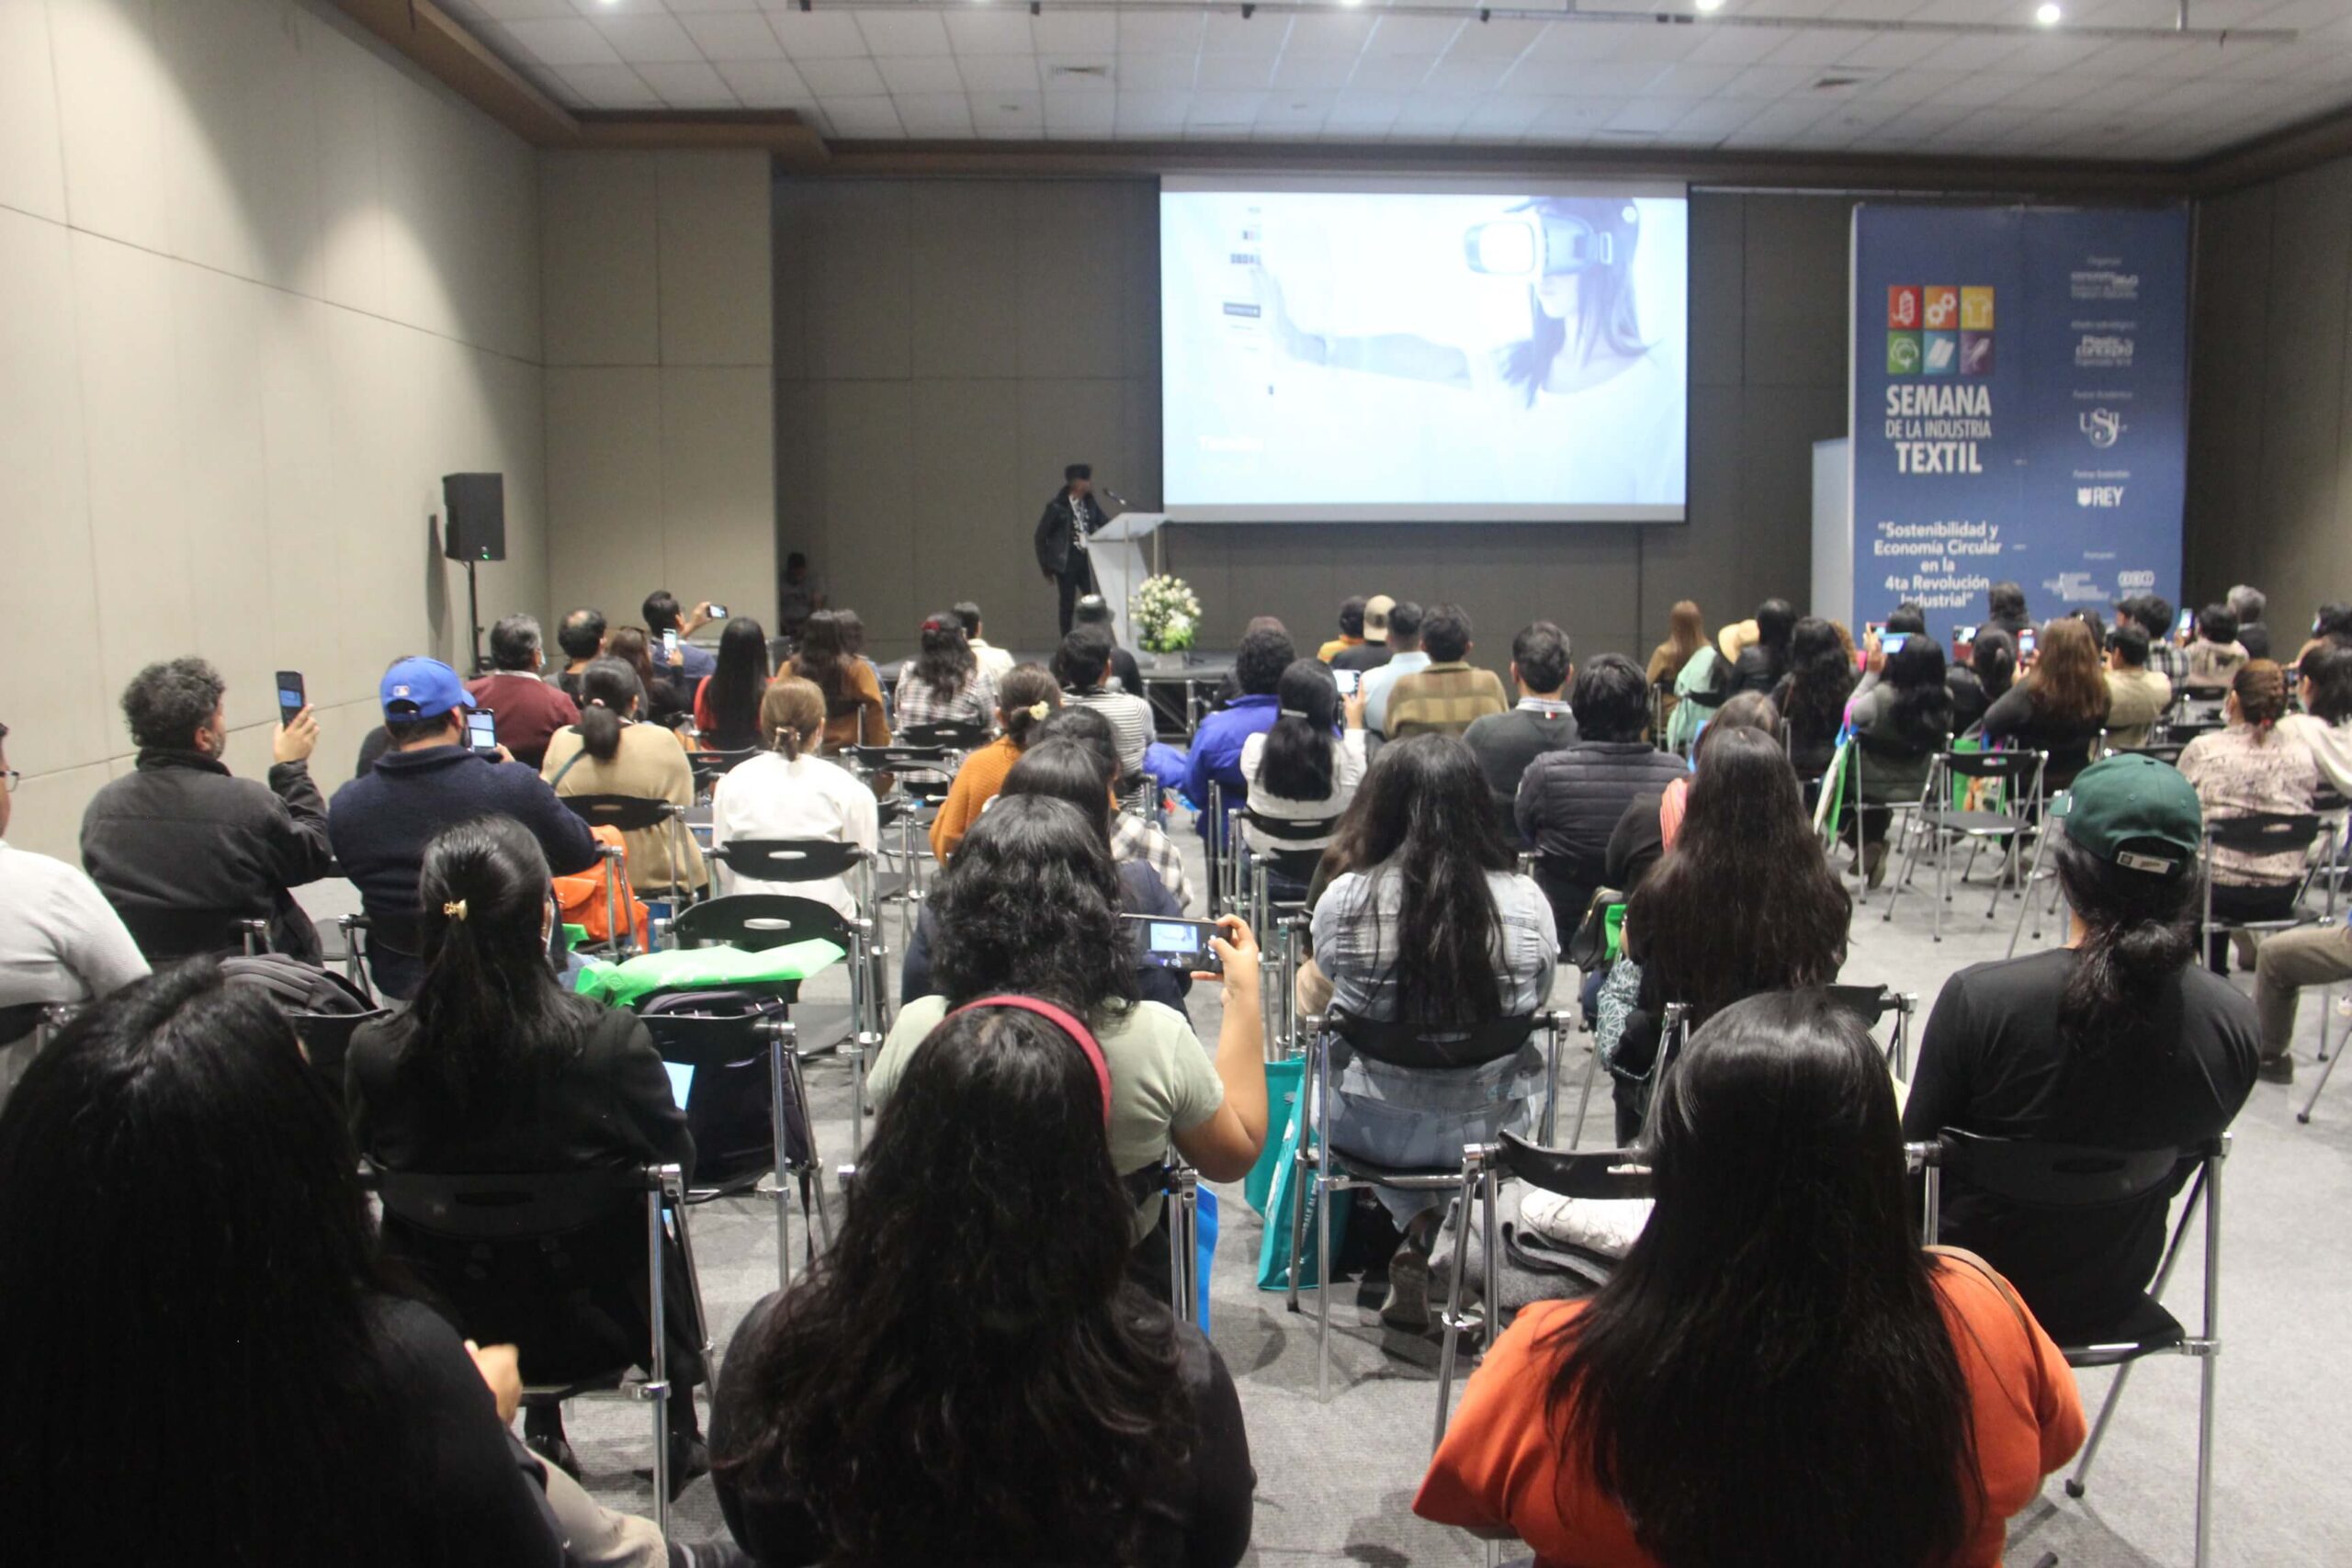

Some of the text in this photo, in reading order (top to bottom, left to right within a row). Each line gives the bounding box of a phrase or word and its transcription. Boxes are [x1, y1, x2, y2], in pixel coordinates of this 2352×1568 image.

[1885, 384, 1992, 416] SEMANA
[1885, 419, 1992, 439] DE LA INDUSTRIA
[1894, 442, 1983, 473] TEXTIL
[2093, 486, 2124, 507] REY
[1989, 525, 1999, 540] y
[1874, 539, 1944, 556] Economía
[1947, 539, 2002, 555] Circular
[1920, 557, 1956, 573] en la
[1885, 574, 1990, 591] 4ta Revolución
